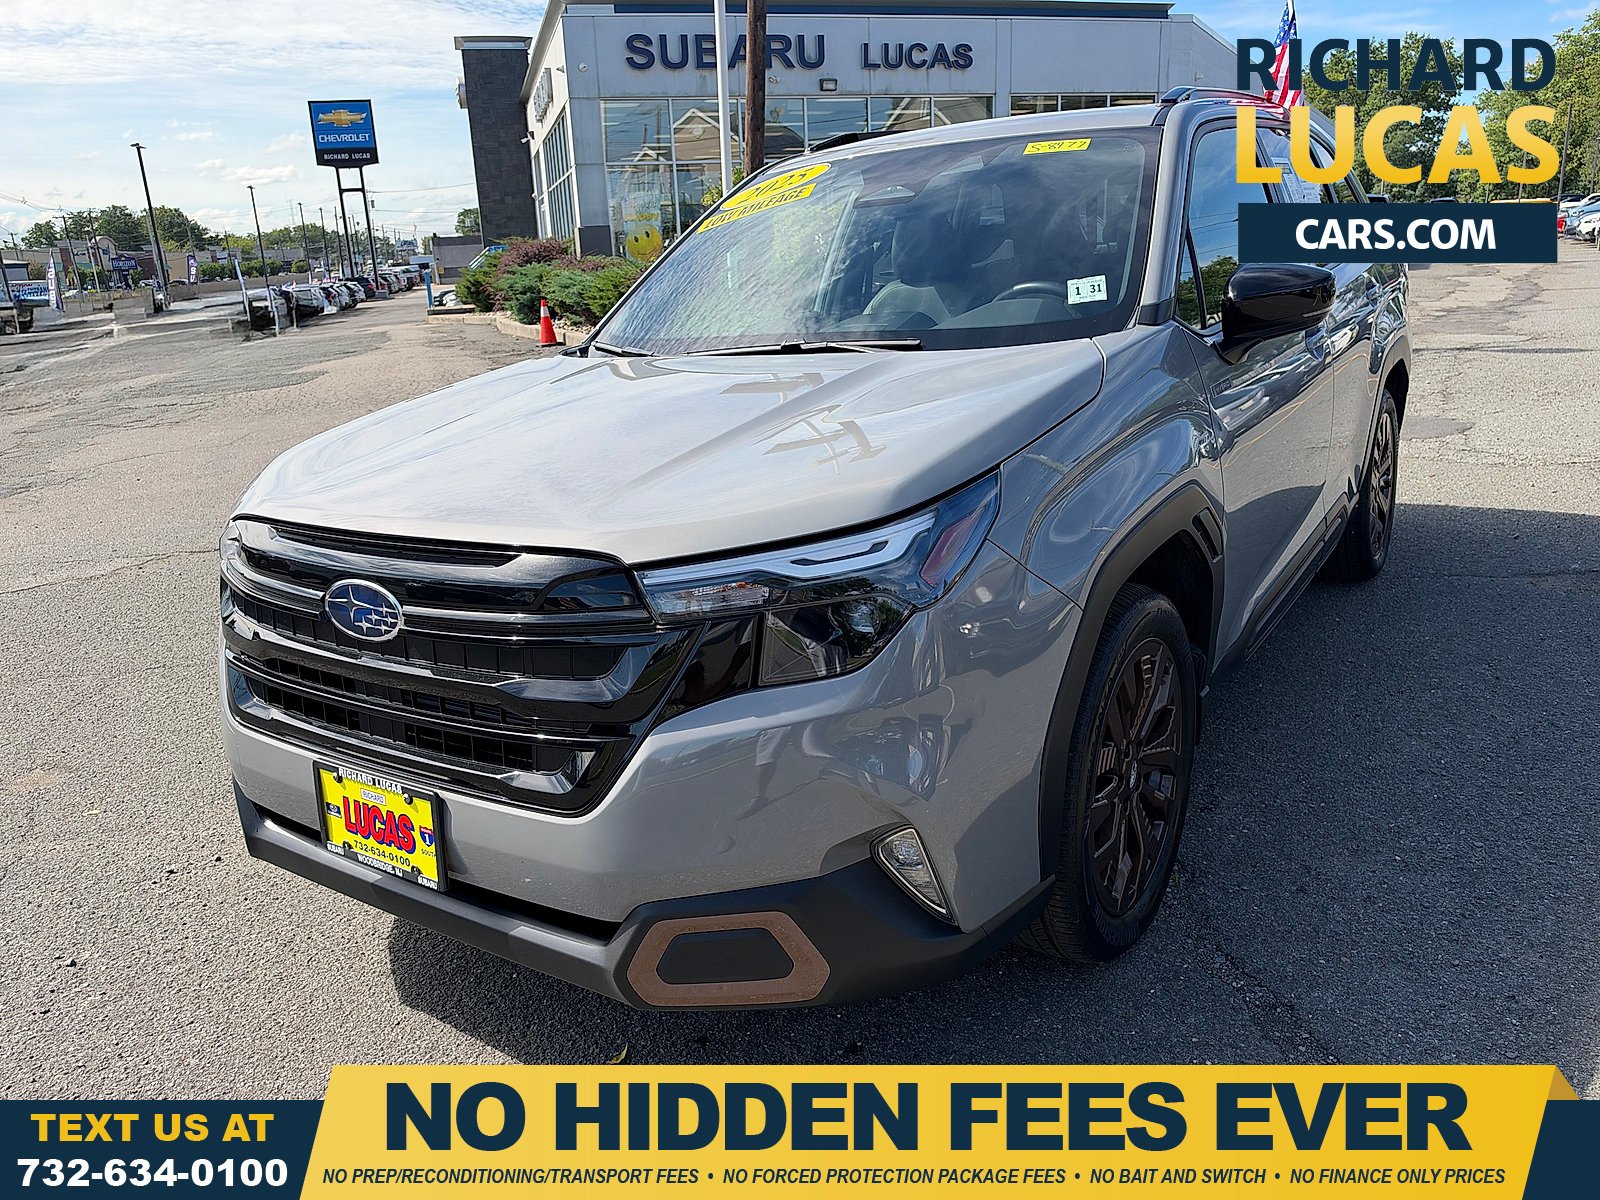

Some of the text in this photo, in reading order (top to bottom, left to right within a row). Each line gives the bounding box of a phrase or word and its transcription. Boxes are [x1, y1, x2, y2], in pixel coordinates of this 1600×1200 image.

[861, 42, 974, 70] LUCAS
[318, 133, 370, 143] CHEVROLET
[351, 152, 371, 160] LUCAS
[704, 187, 806, 230] LOW MILEAGE
[1075, 283, 1102, 296] 1 31
[338, 767, 403, 794] RICHARD LUCAS
[343, 796, 416, 854] LUCAS
[423, 833, 431, 846] 1
